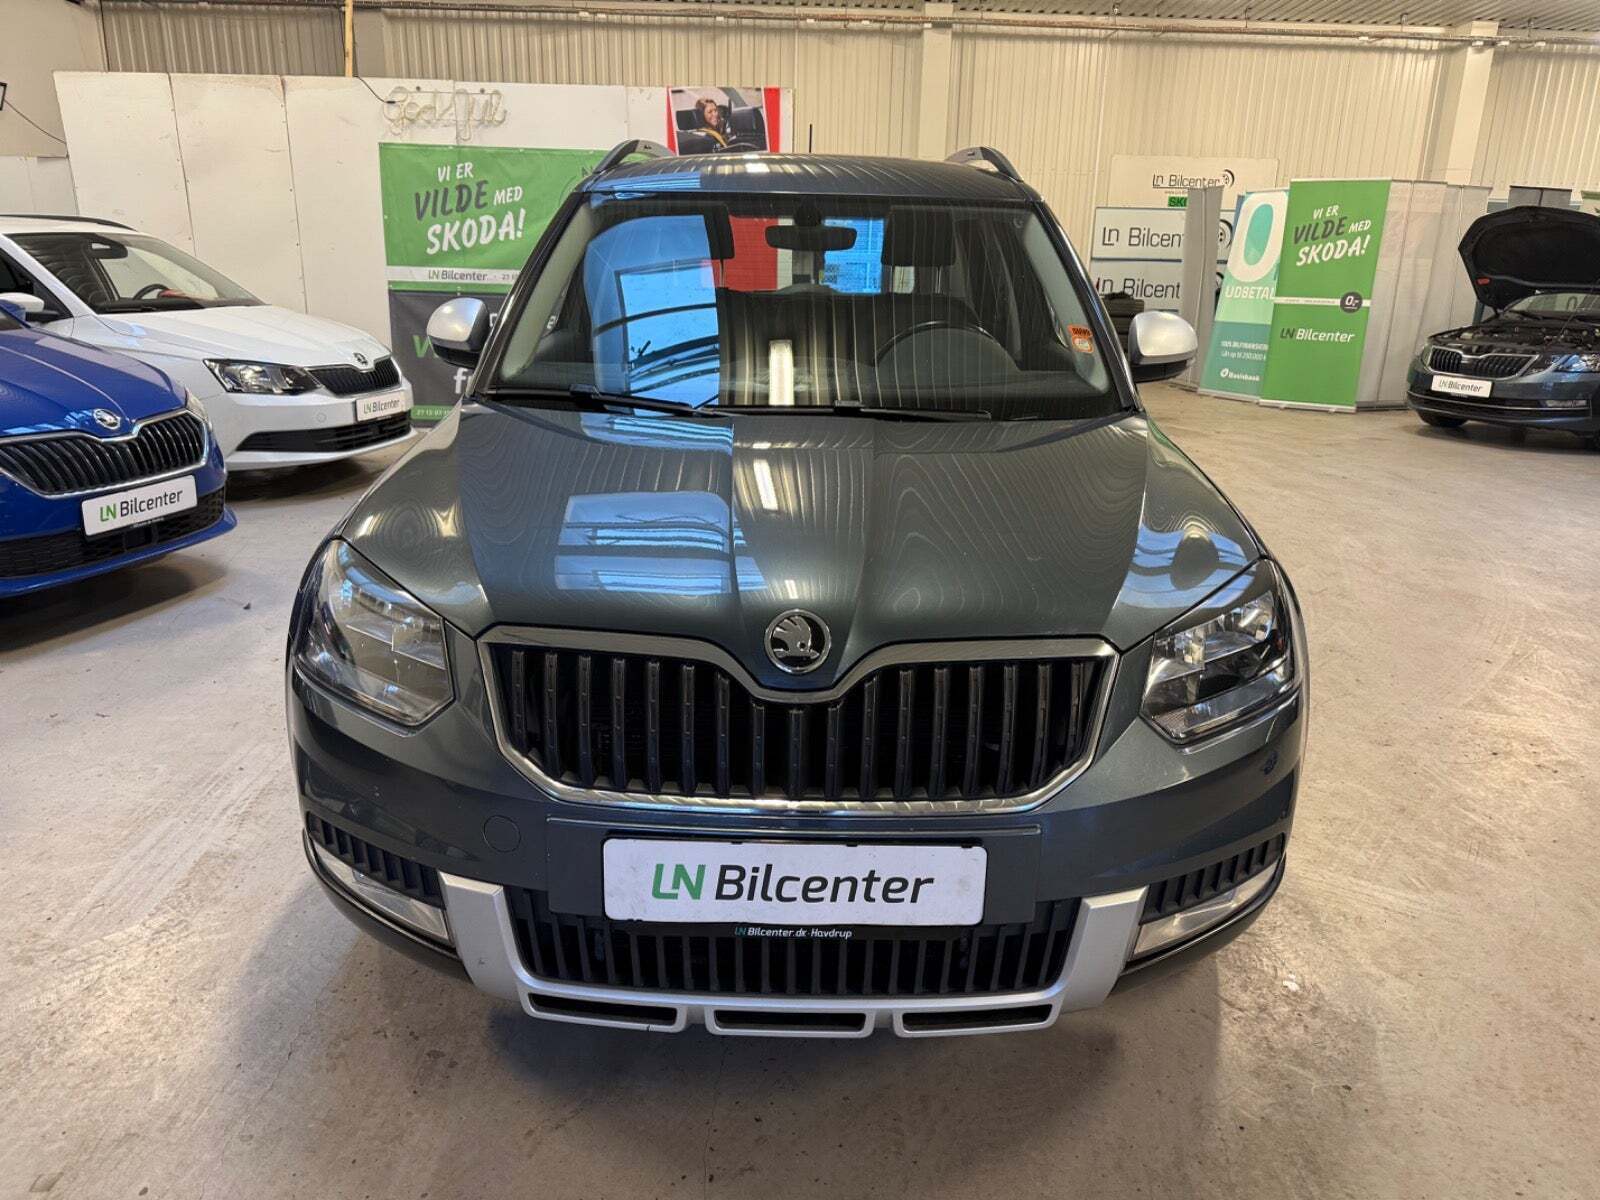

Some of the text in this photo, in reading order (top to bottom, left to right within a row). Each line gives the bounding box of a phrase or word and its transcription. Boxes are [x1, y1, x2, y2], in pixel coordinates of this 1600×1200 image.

[437, 162, 474, 182] VI ER
[1168, 174, 1220, 188] Bilcenter
[415, 180, 523, 221] VILDE MED
[1313, 205, 1339, 220] VI ER
[426, 207, 526, 255] SKODA!
[1128, 227, 1184, 248] Bilcen
[1294, 216, 1371, 244] VILDE MED
[1296, 234, 1371, 267] SKODA!
[428, 269, 439, 280] LN
[1123, 278, 1181, 299] Bilcent
[1225, 285, 1276, 300] UDBETAL
[1280, 328, 1355, 343] LN Bilcenter
[100, 490, 183, 522] LN Bilcenter
[651, 863, 935, 904] LN Bilcenter
[811, 928, 853, 940] Havdrup
